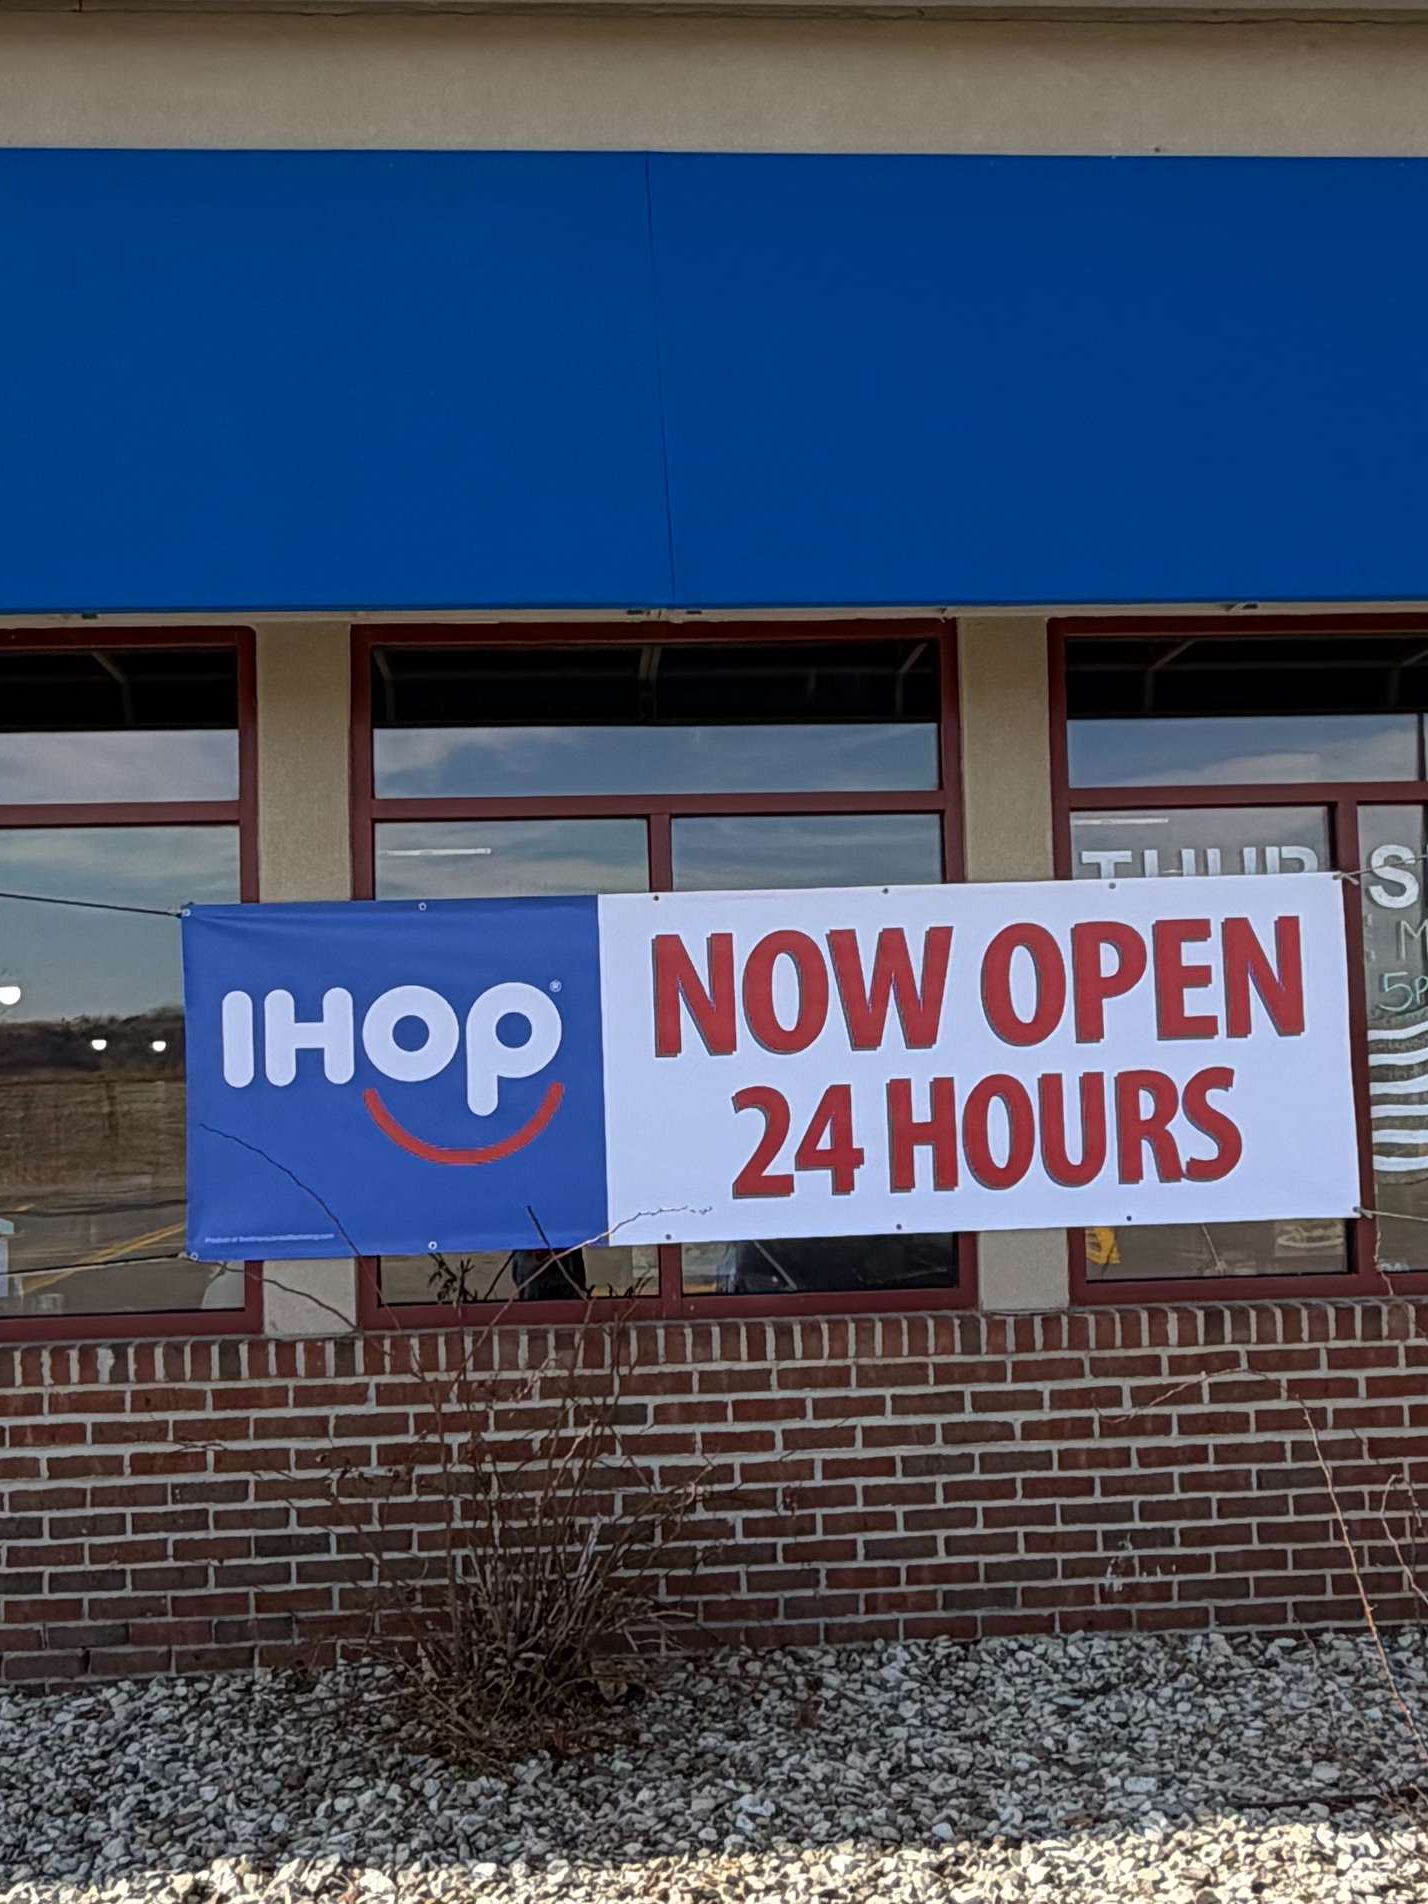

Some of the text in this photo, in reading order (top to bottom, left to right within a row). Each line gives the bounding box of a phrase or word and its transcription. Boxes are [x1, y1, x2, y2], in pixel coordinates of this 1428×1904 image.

[222, 982, 563, 1116] IHOP
[651, 915, 1304, 1057] NOW OPEN
[732, 1067, 1242, 1199] 24 HOURS
